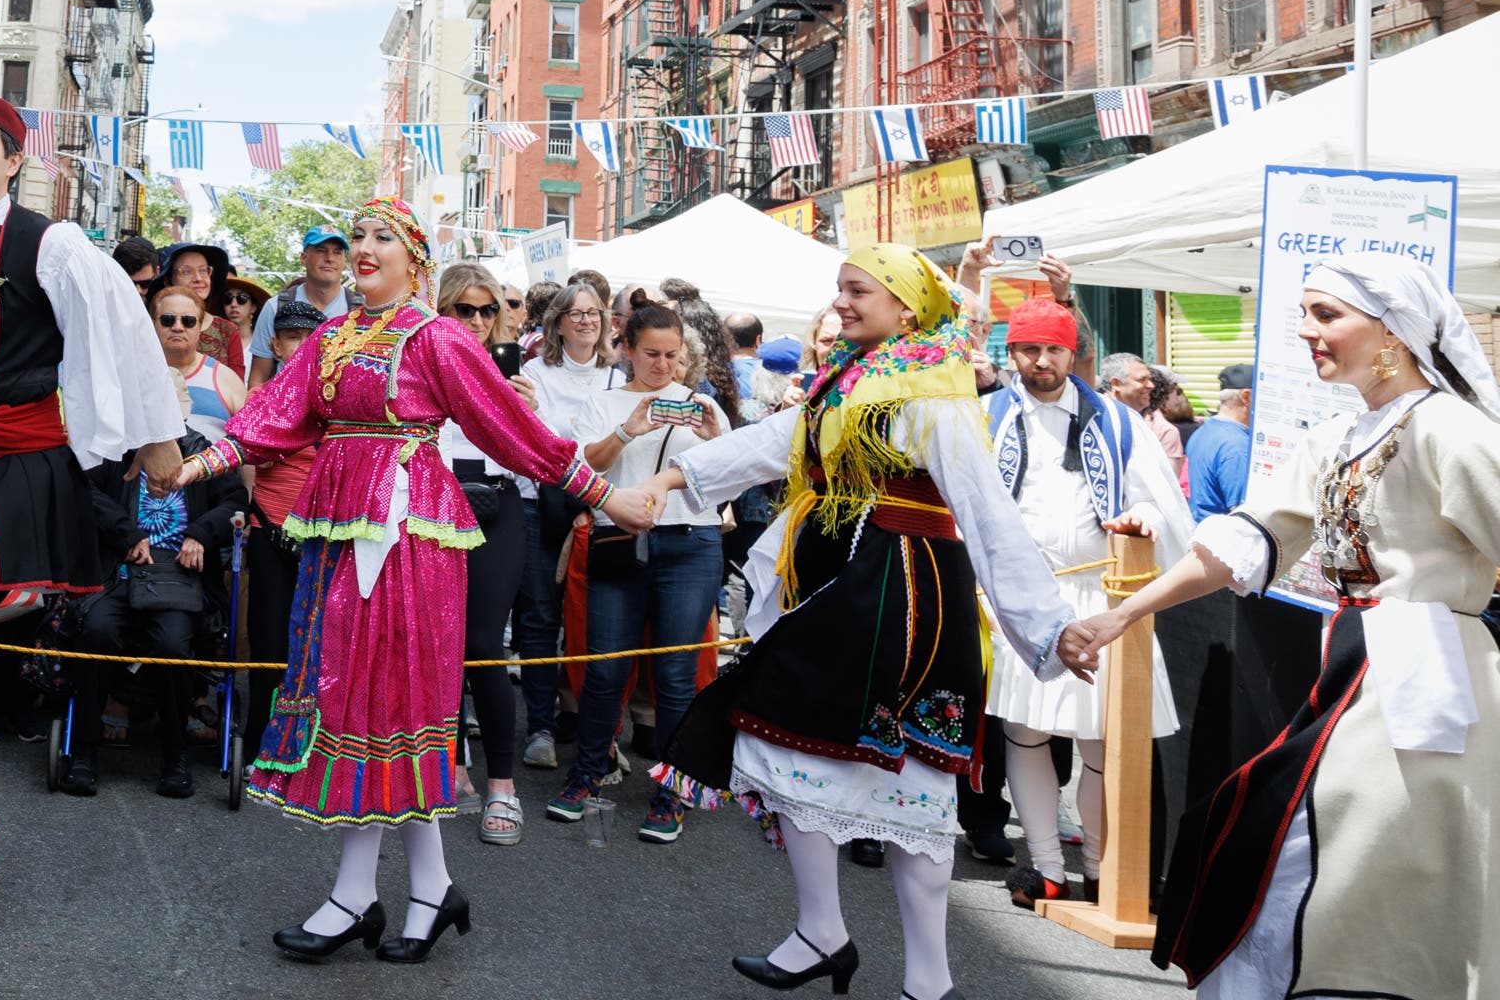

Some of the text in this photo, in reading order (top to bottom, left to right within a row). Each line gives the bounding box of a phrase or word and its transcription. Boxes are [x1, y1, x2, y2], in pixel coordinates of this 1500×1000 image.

[902, 201, 949, 223] TRADING
[951, 195, 975, 214] INC.
[1277, 231, 1347, 256] GREEK
